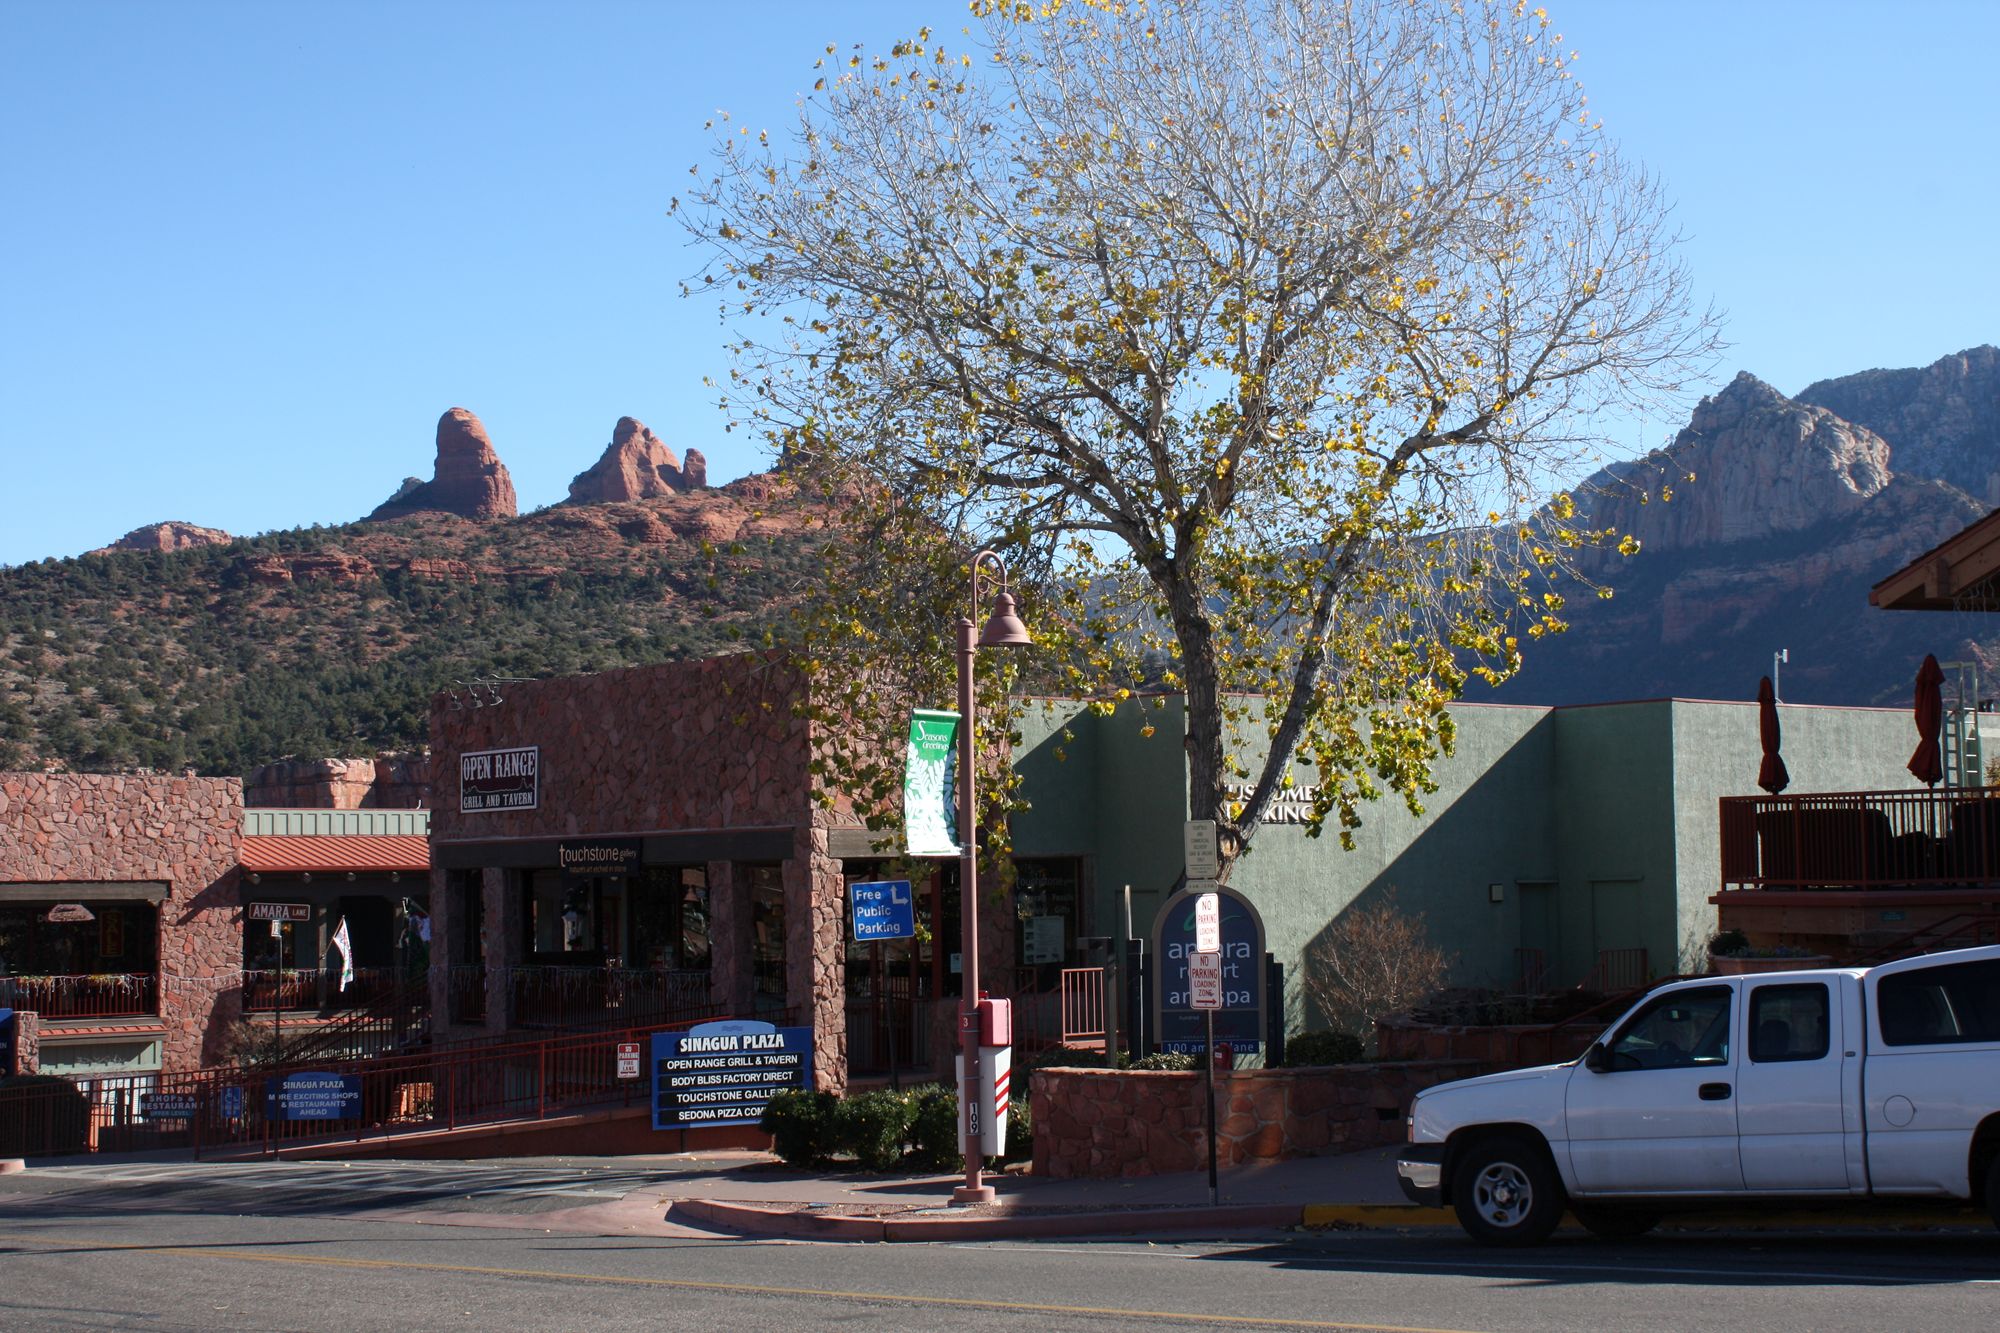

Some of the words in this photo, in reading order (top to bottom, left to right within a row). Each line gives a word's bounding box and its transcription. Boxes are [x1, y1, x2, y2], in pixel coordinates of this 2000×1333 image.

[463, 755, 492, 781] OPEN
[495, 752, 535, 778] RANGE
[463, 795, 484, 808] GRILL
[485, 794, 501, 807] AND
[502, 791, 533, 806] TAVERN
[559, 844, 619, 868] touchstone
[855, 889, 882, 901] Free
[252, 904, 290, 919] AMARA
[292, 907, 307, 917] LANE
[856, 905, 892, 917] Public
[1201, 900, 1212, 911] NO
[858, 921, 901, 934] Parking
[1200, 956, 1209, 967] NO
[1192, 969, 1218, 979] PARKING
[963, 1018, 968, 1027] 3
[680, 1037, 739, 1053] SINAGUA
[743, 1033, 785, 1050] PLAZA
[667, 1060, 693, 1070] OPEN
[694, 1058, 726, 1068] RANGE
[727, 1057, 754, 1067] GRILL
[755, 1056, 763, 1065] &
[763, 1055, 798, 1065] TAVERN
[282, 1081, 318, 1090] SINAGUA
[319, 1080, 345, 1089] PLAZA
[671, 1076, 697, 1087] BODY
[697, 1075, 722, 1085] BLISS
[722, 1073, 763, 1084] FACTORY
[763, 1071, 794, 1081] DIRECT
[677, 1092, 743, 1103] TOUCHSTONE
[288, 1100, 347, 1108] RESTAURANTS
[299, 1108, 328, 1116] AHEAD
[678, 1110, 716, 1121] SEDONA
[717, 1108, 743, 1118] PIZZA
[970, 1103, 978, 1133] 109
